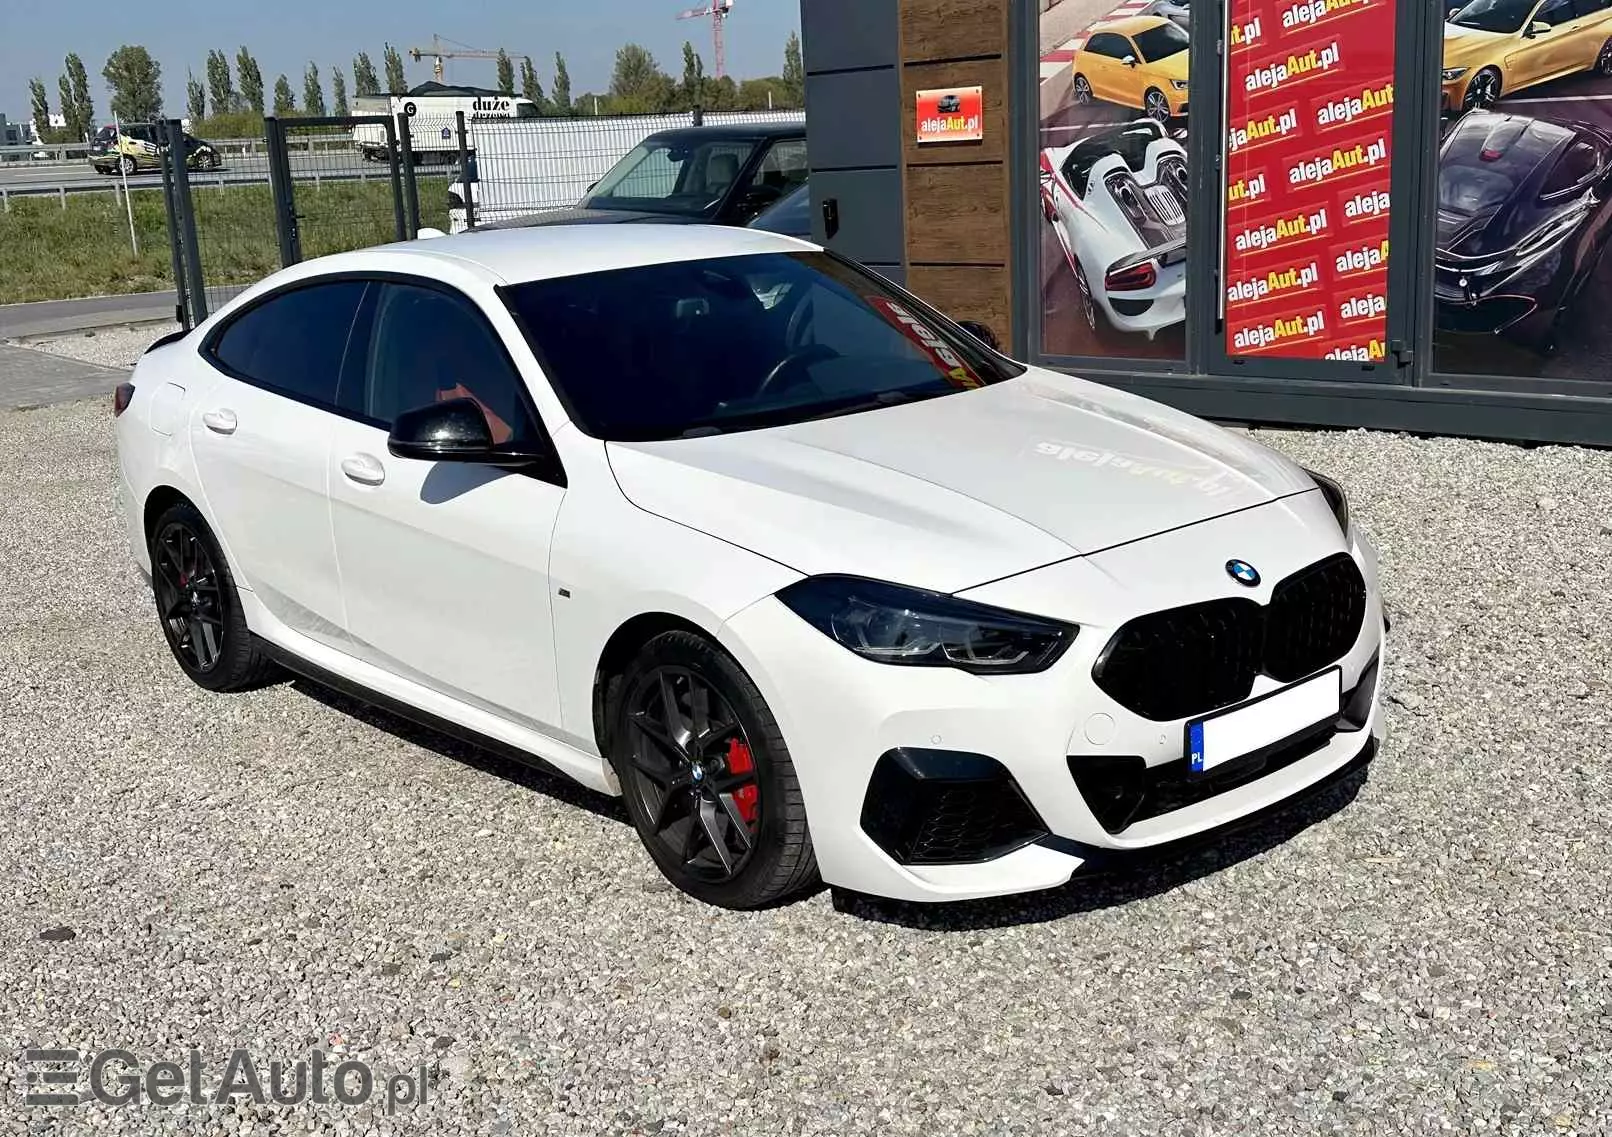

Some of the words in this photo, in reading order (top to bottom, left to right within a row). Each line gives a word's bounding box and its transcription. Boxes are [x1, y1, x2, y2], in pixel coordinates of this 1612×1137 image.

[1245, 41, 1340, 91] alejaAut.pl
[473, 96, 510, 110] duże
[1317, 84, 1393, 125] alejaAut
[921, 115, 979, 132] alejaAut.pl
[1289, 138, 1386, 184] alejaAut.pl
[1345, 190, 1390, 218] aleja
[1235, 208, 1327, 250] alejaAut.pl
[1227, 262, 1318, 302] alejaAut.pl
[1340, 293, 1385, 319] aleja
[1233, 311, 1325, 348] alejaAut.pl
[1191, 752, 1203, 765] PL
